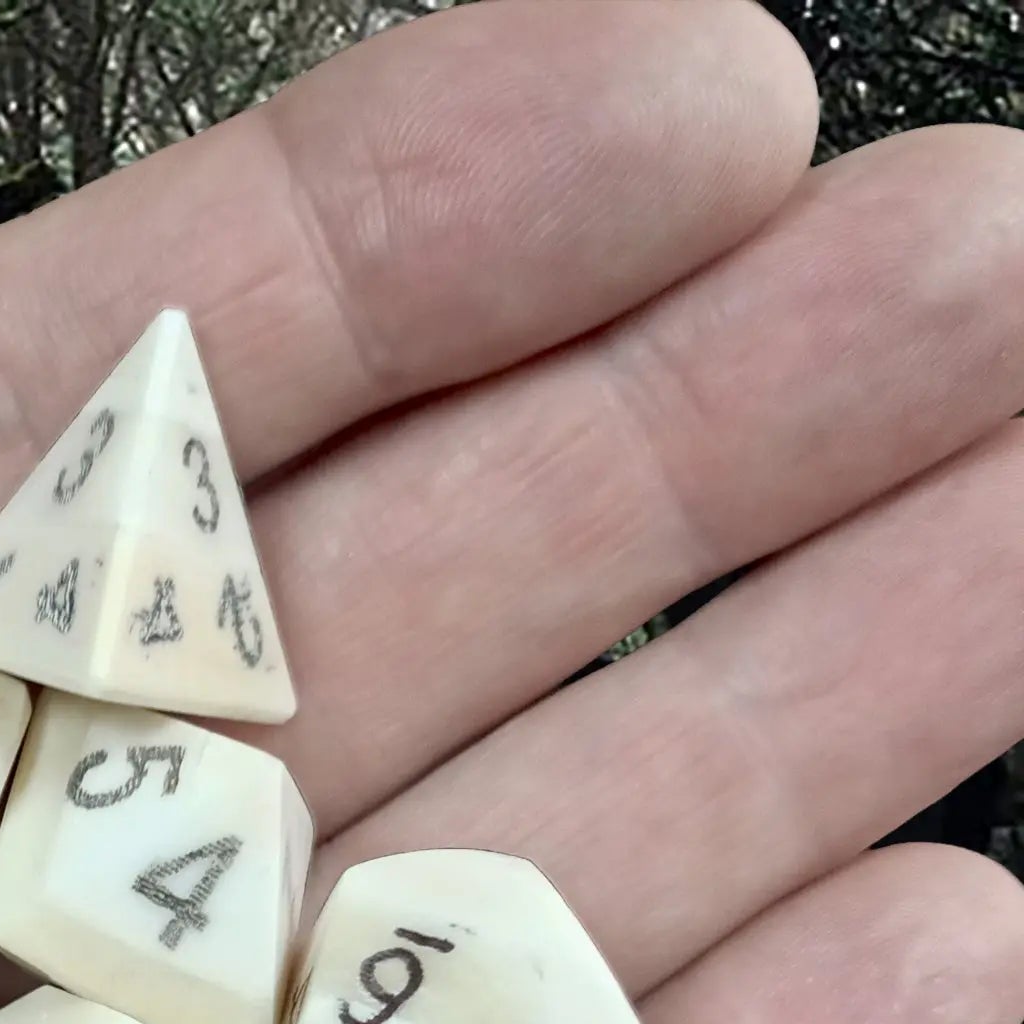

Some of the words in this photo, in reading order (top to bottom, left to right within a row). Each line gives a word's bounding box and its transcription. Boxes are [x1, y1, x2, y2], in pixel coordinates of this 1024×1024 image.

[182, 437, 221, 534] 3
[65, 744, 187, 811] 5
[132, 834, 244, 951] 4
